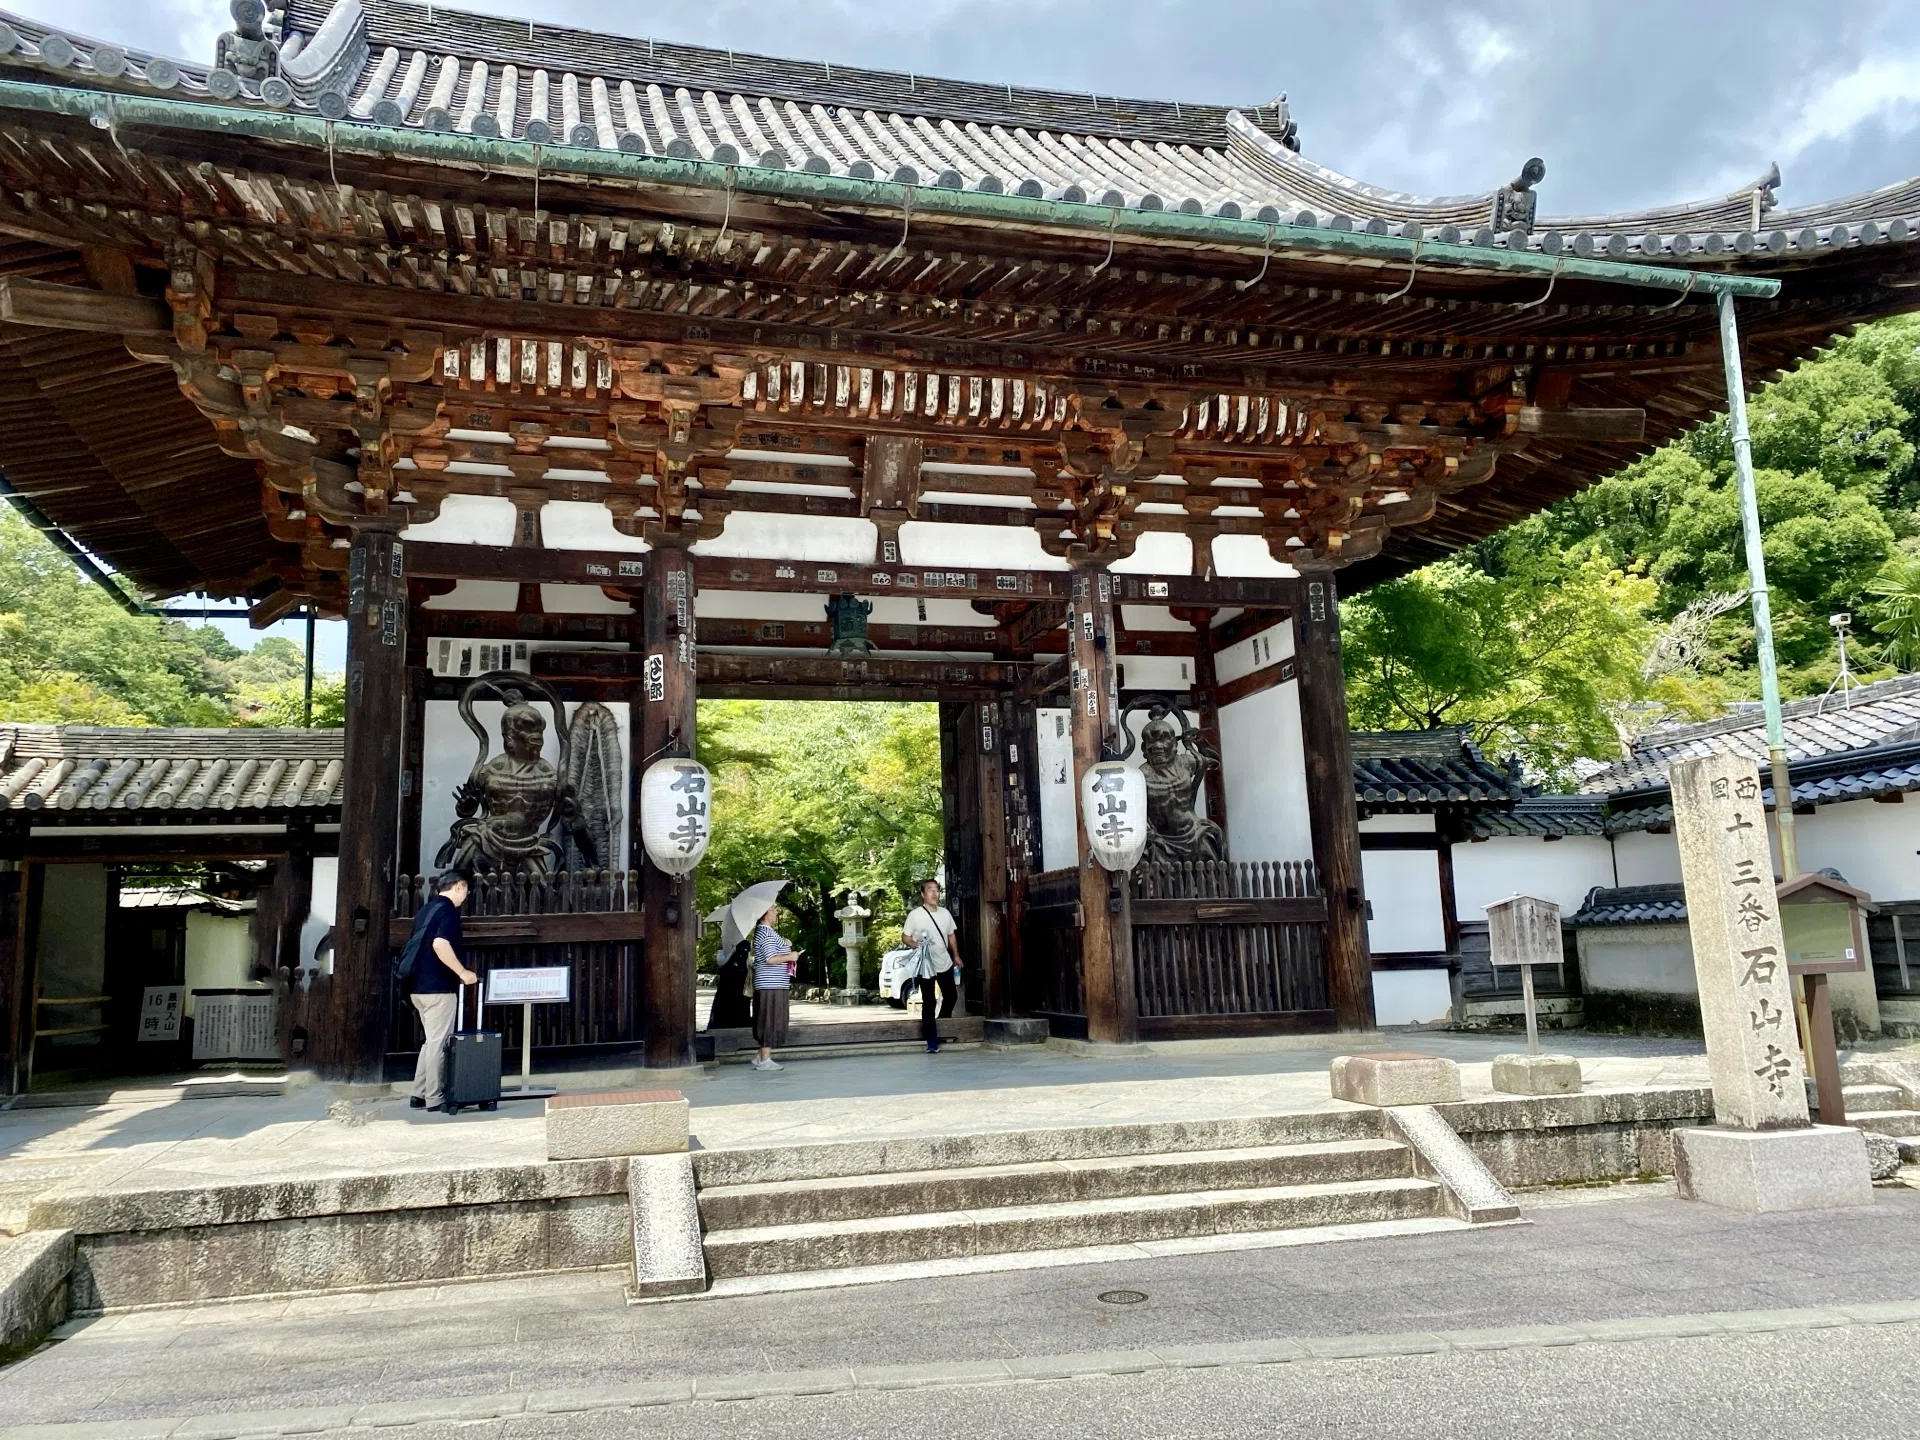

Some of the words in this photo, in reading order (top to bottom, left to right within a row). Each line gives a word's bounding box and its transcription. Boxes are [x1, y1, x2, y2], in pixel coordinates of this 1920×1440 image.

[670, 765, 707, 854] 石山寺
[1091, 767, 1134, 849] 石山寺
[163, 992, 178, 1031] 最終入山
